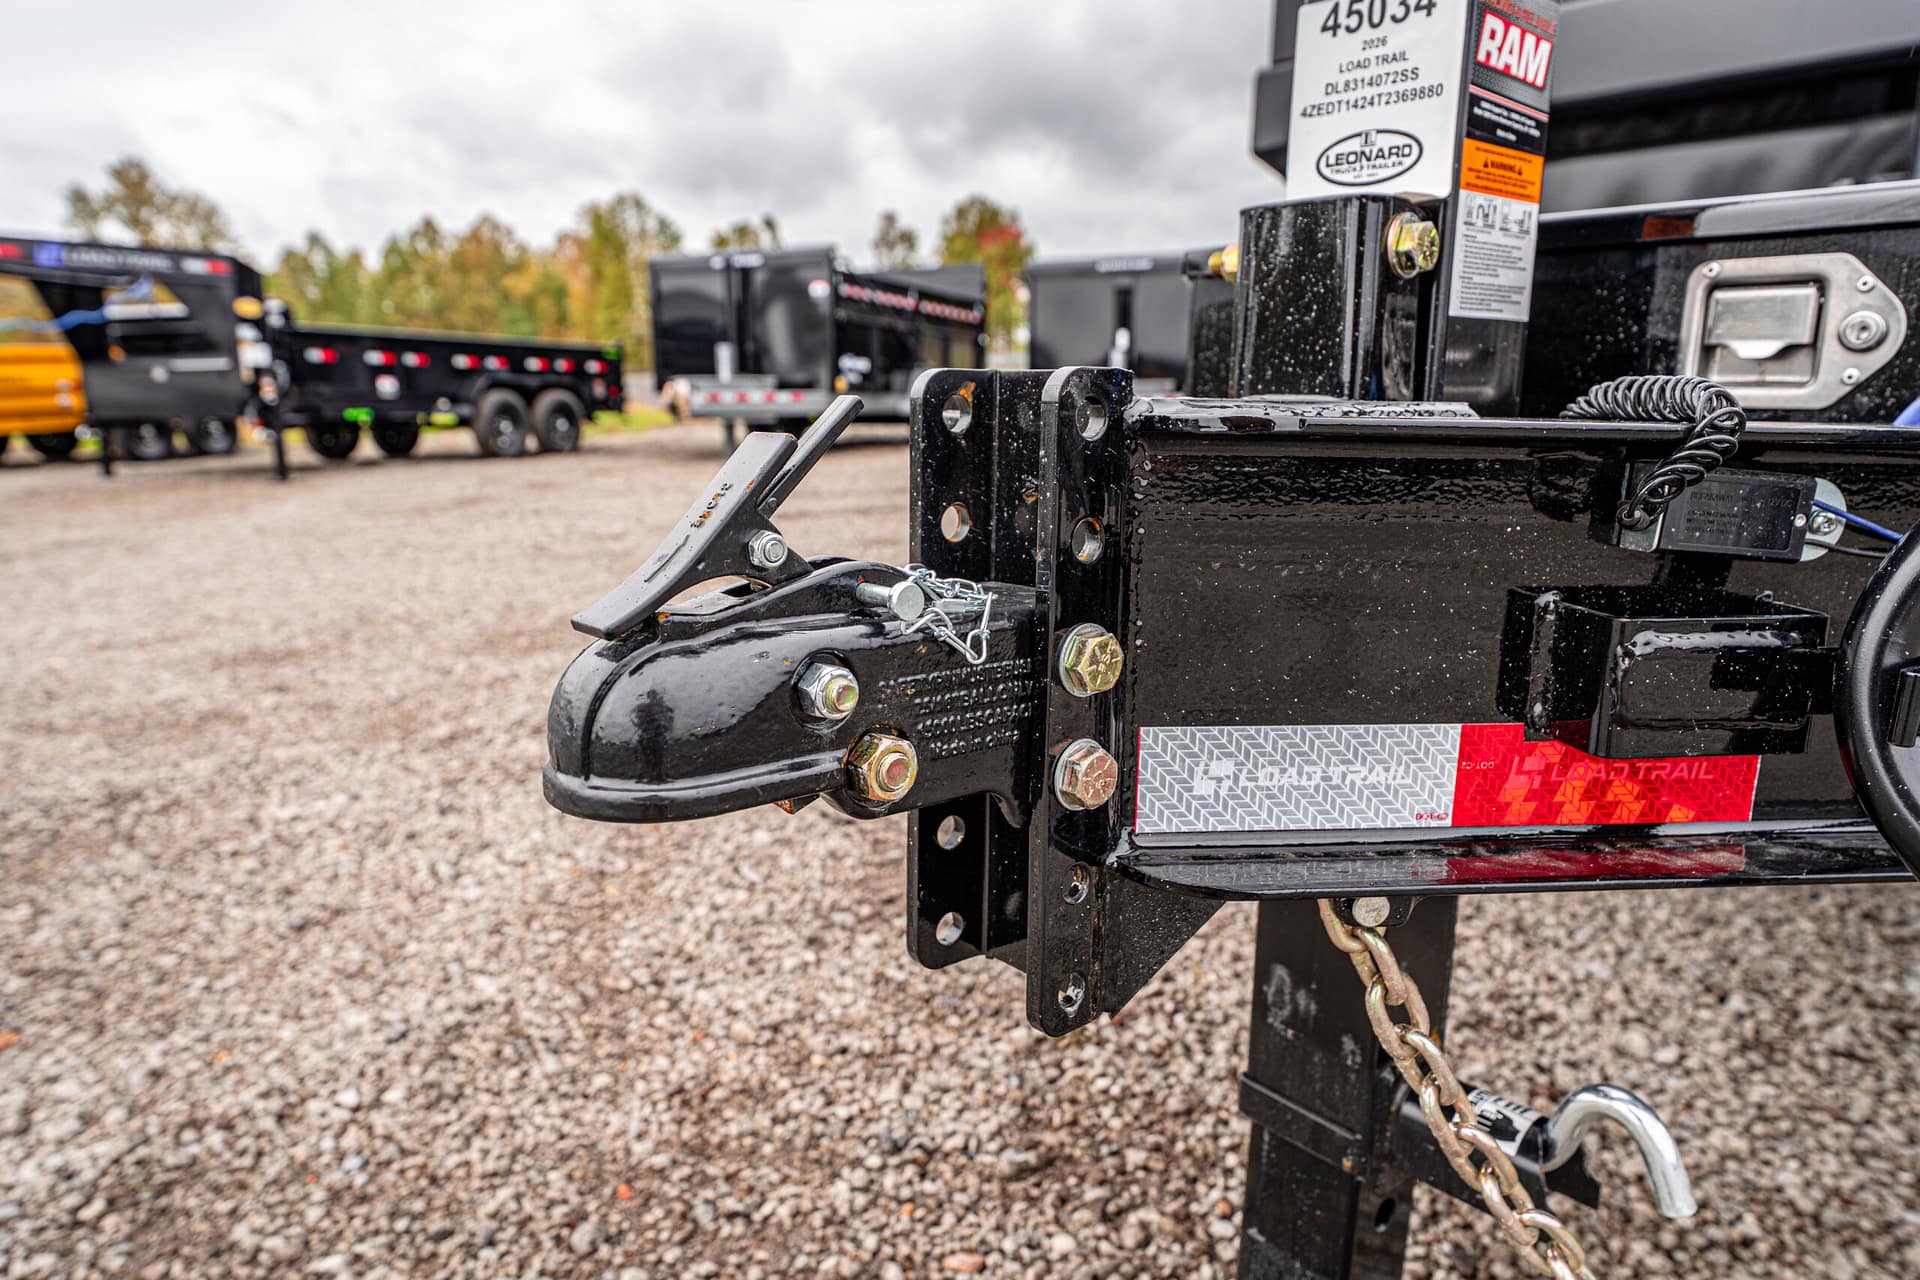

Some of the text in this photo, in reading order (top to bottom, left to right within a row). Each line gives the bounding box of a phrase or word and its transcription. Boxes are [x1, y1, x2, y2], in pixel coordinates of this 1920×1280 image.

[1361, 36, 1388, 51] 2026
[1477, 13, 1552, 88] RAM
[1339, 51, 1409, 73] LOAD TRAIL
[1324, 67, 1420, 96] DL8314072SS
[1325, 144, 1412, 168] LEONARD
[1239, 764, 1410, 786] LOAD TRAIL
[1550, 761, 1714, 782] LOAD TRAIL
